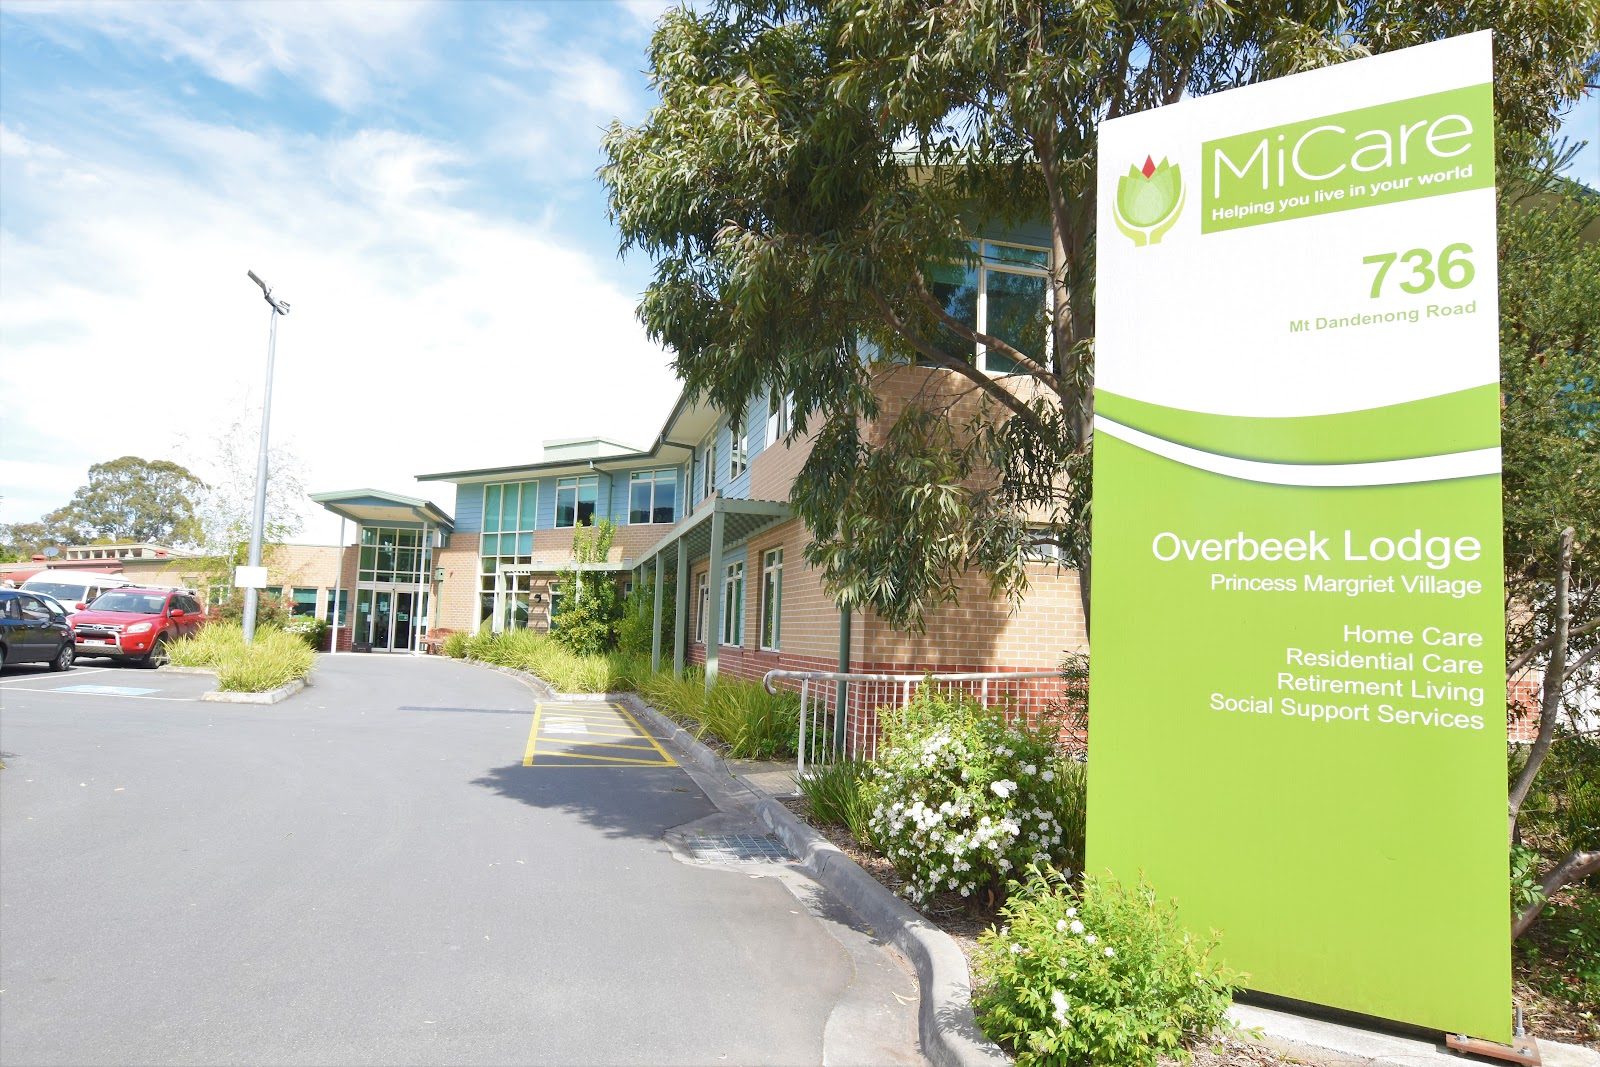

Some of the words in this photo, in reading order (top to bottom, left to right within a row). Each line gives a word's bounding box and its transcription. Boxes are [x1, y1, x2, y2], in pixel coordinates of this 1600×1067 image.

[1213, 114, 1473, 199] MiCare
[1212, 202, 1275, 222] Helping
[1279, 195, 1309, 212] you
[1315, 190, 1344, 202] live
[1350, 185, 1365, 196] in
[1371, 178, 1413, 196] your
[1418, 164, 1472, 184] world
[1363, 243, 1475, 298] 736
[1290, 320, 1309, 332] Mt
[1316, 310, 1419, 329] Dandenong
[1427, 301, 1476, 317] Road
[1153, 530, 1330, 561] Overbeek
[1345, 529, 1481, 569] Lodge
[1212, 574, 1297, 591] Princess
[1305, 575, 1394, 596] Margriet
[1401, 576, 1481, 598] Village
[1344, 625, 1413, 644] Home
[1422, 627, 1482, 647] Care
[1287, 648, 1413, 670] Residential
[1423, 654, 1483, 674] Care
[1278, 673, 1403, 697] Retirement
[1412, 680, 1484, 706] Living
[1210, 693, 1272, 713] Social
[1281, 698, 1369, 722] Support
[1378, 704, 1484, 729] Services
